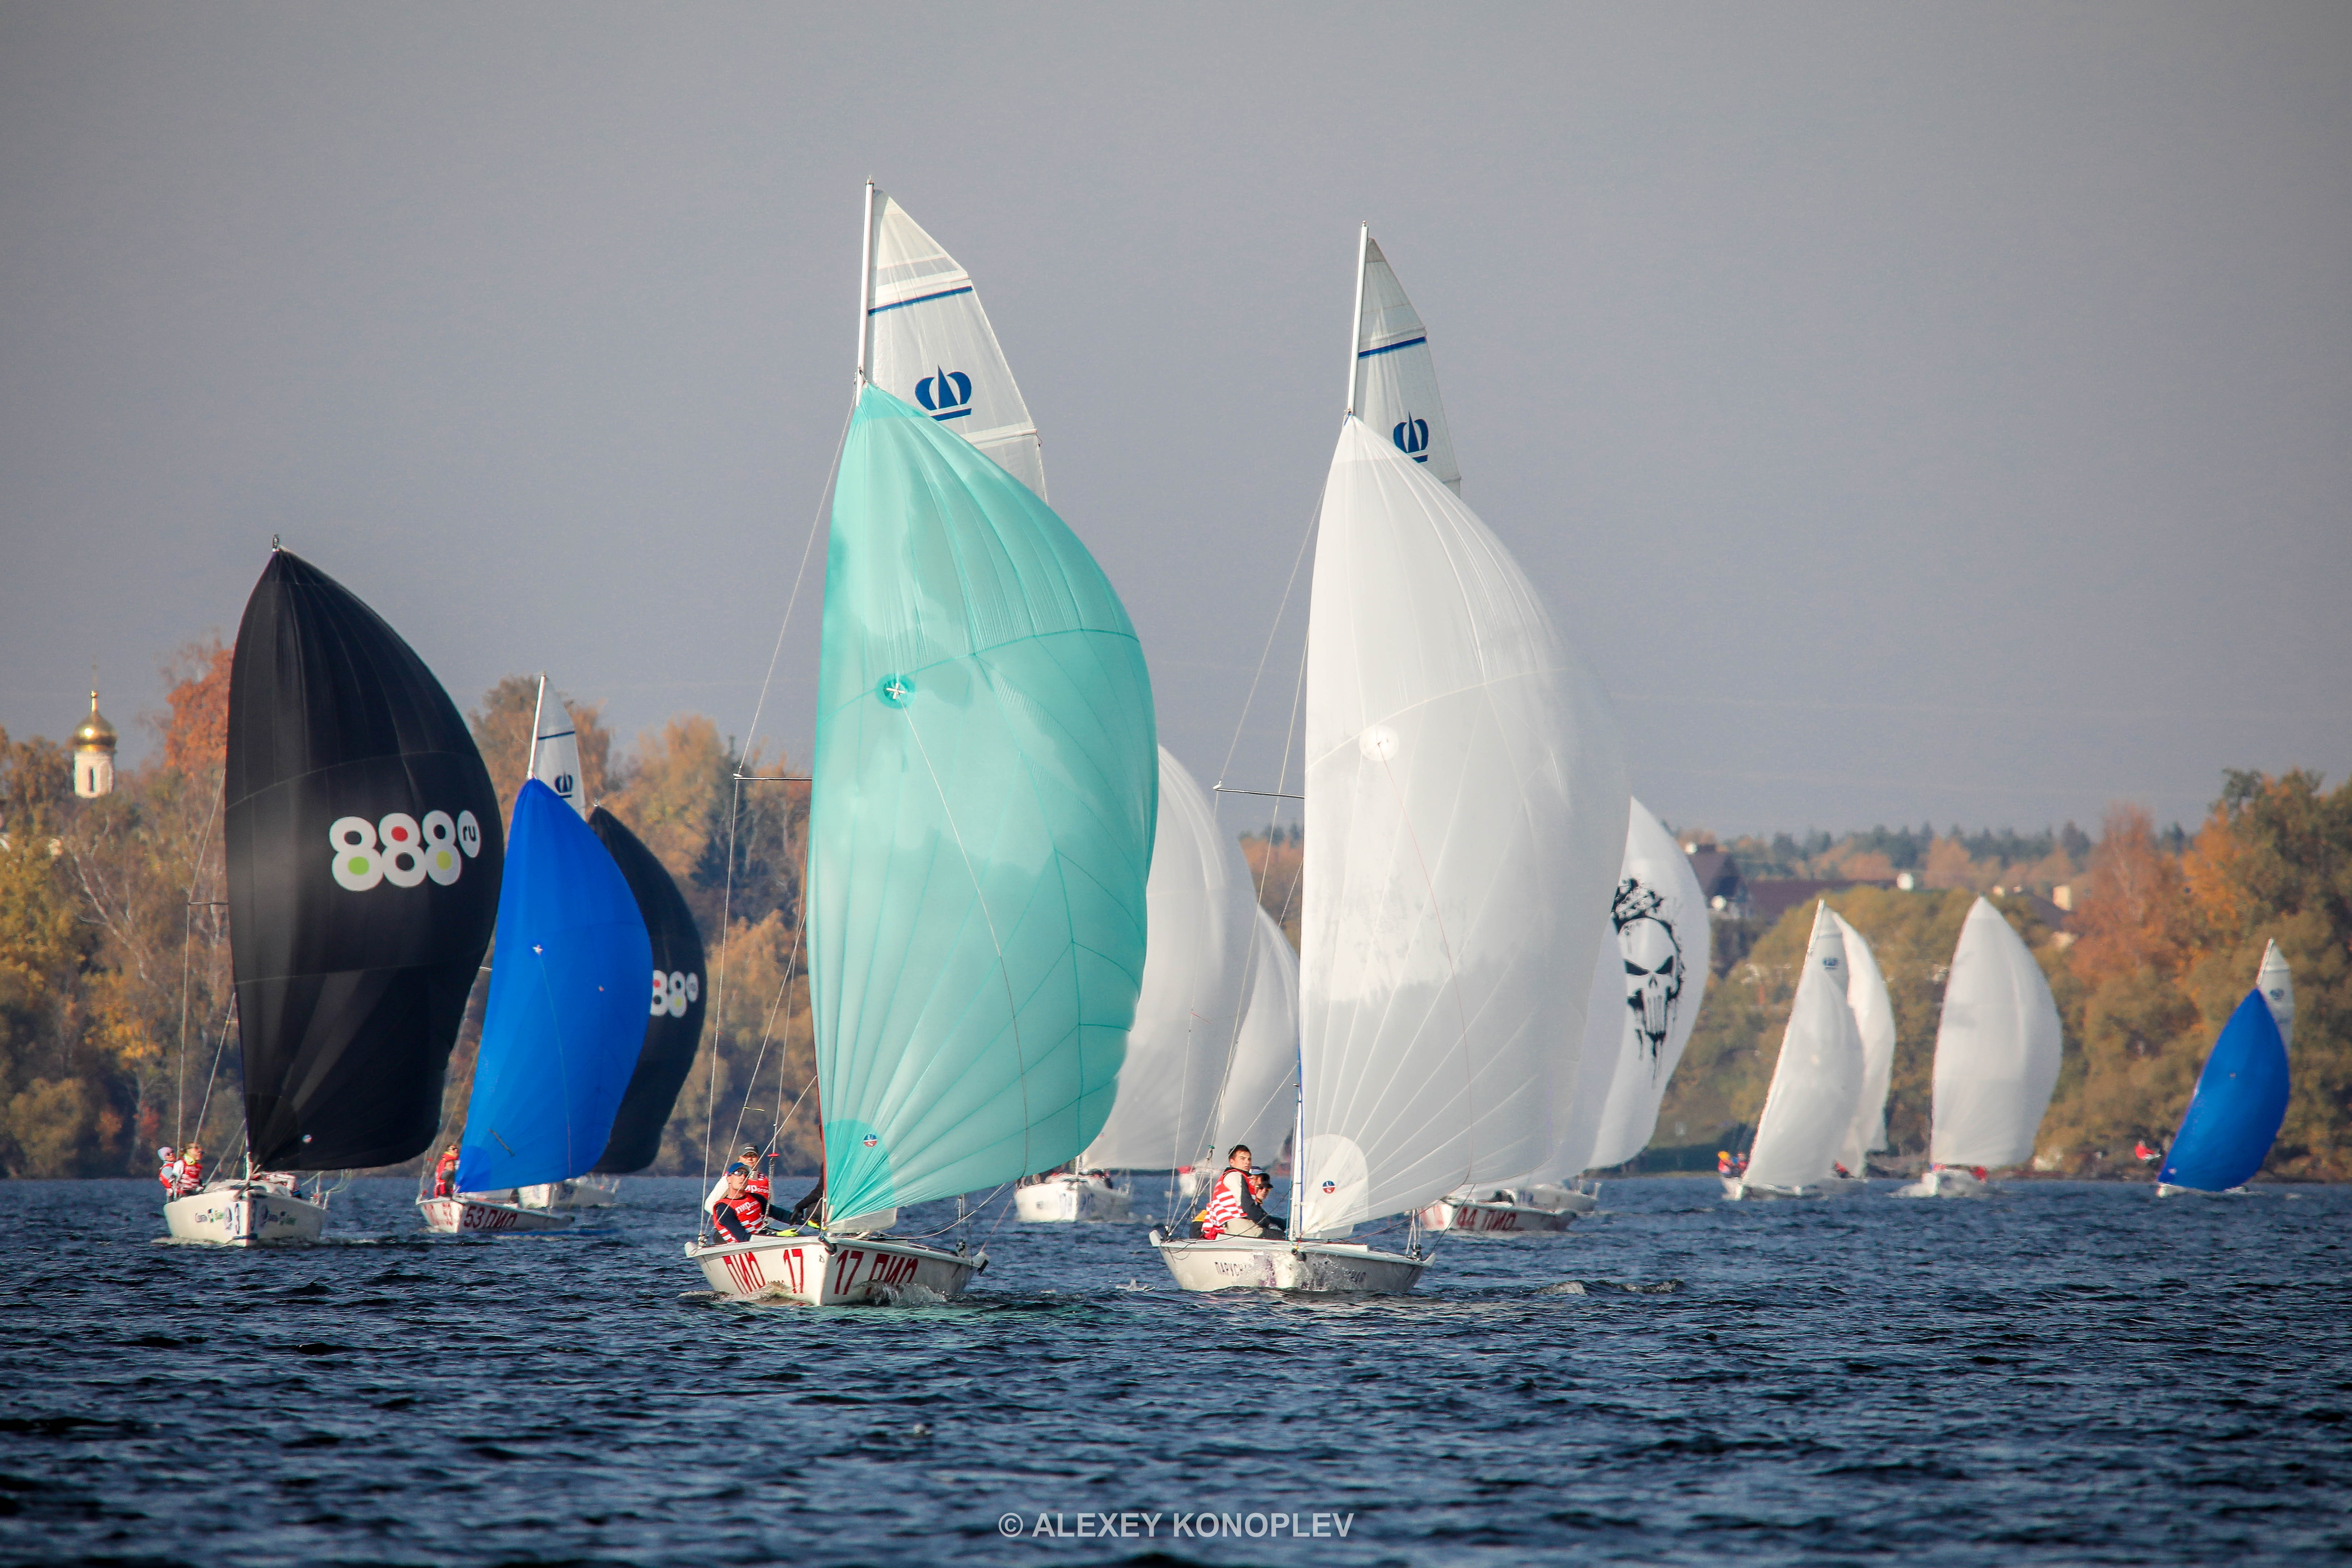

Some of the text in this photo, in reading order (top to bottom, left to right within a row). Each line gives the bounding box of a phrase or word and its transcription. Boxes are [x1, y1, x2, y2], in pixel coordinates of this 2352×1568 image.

[329, 810, 463, 892] 888
[464, 1206, 485, 1228] 53
[783, 1249, 803, 1293] 17
[834, 1249, 865, 1295] 17
